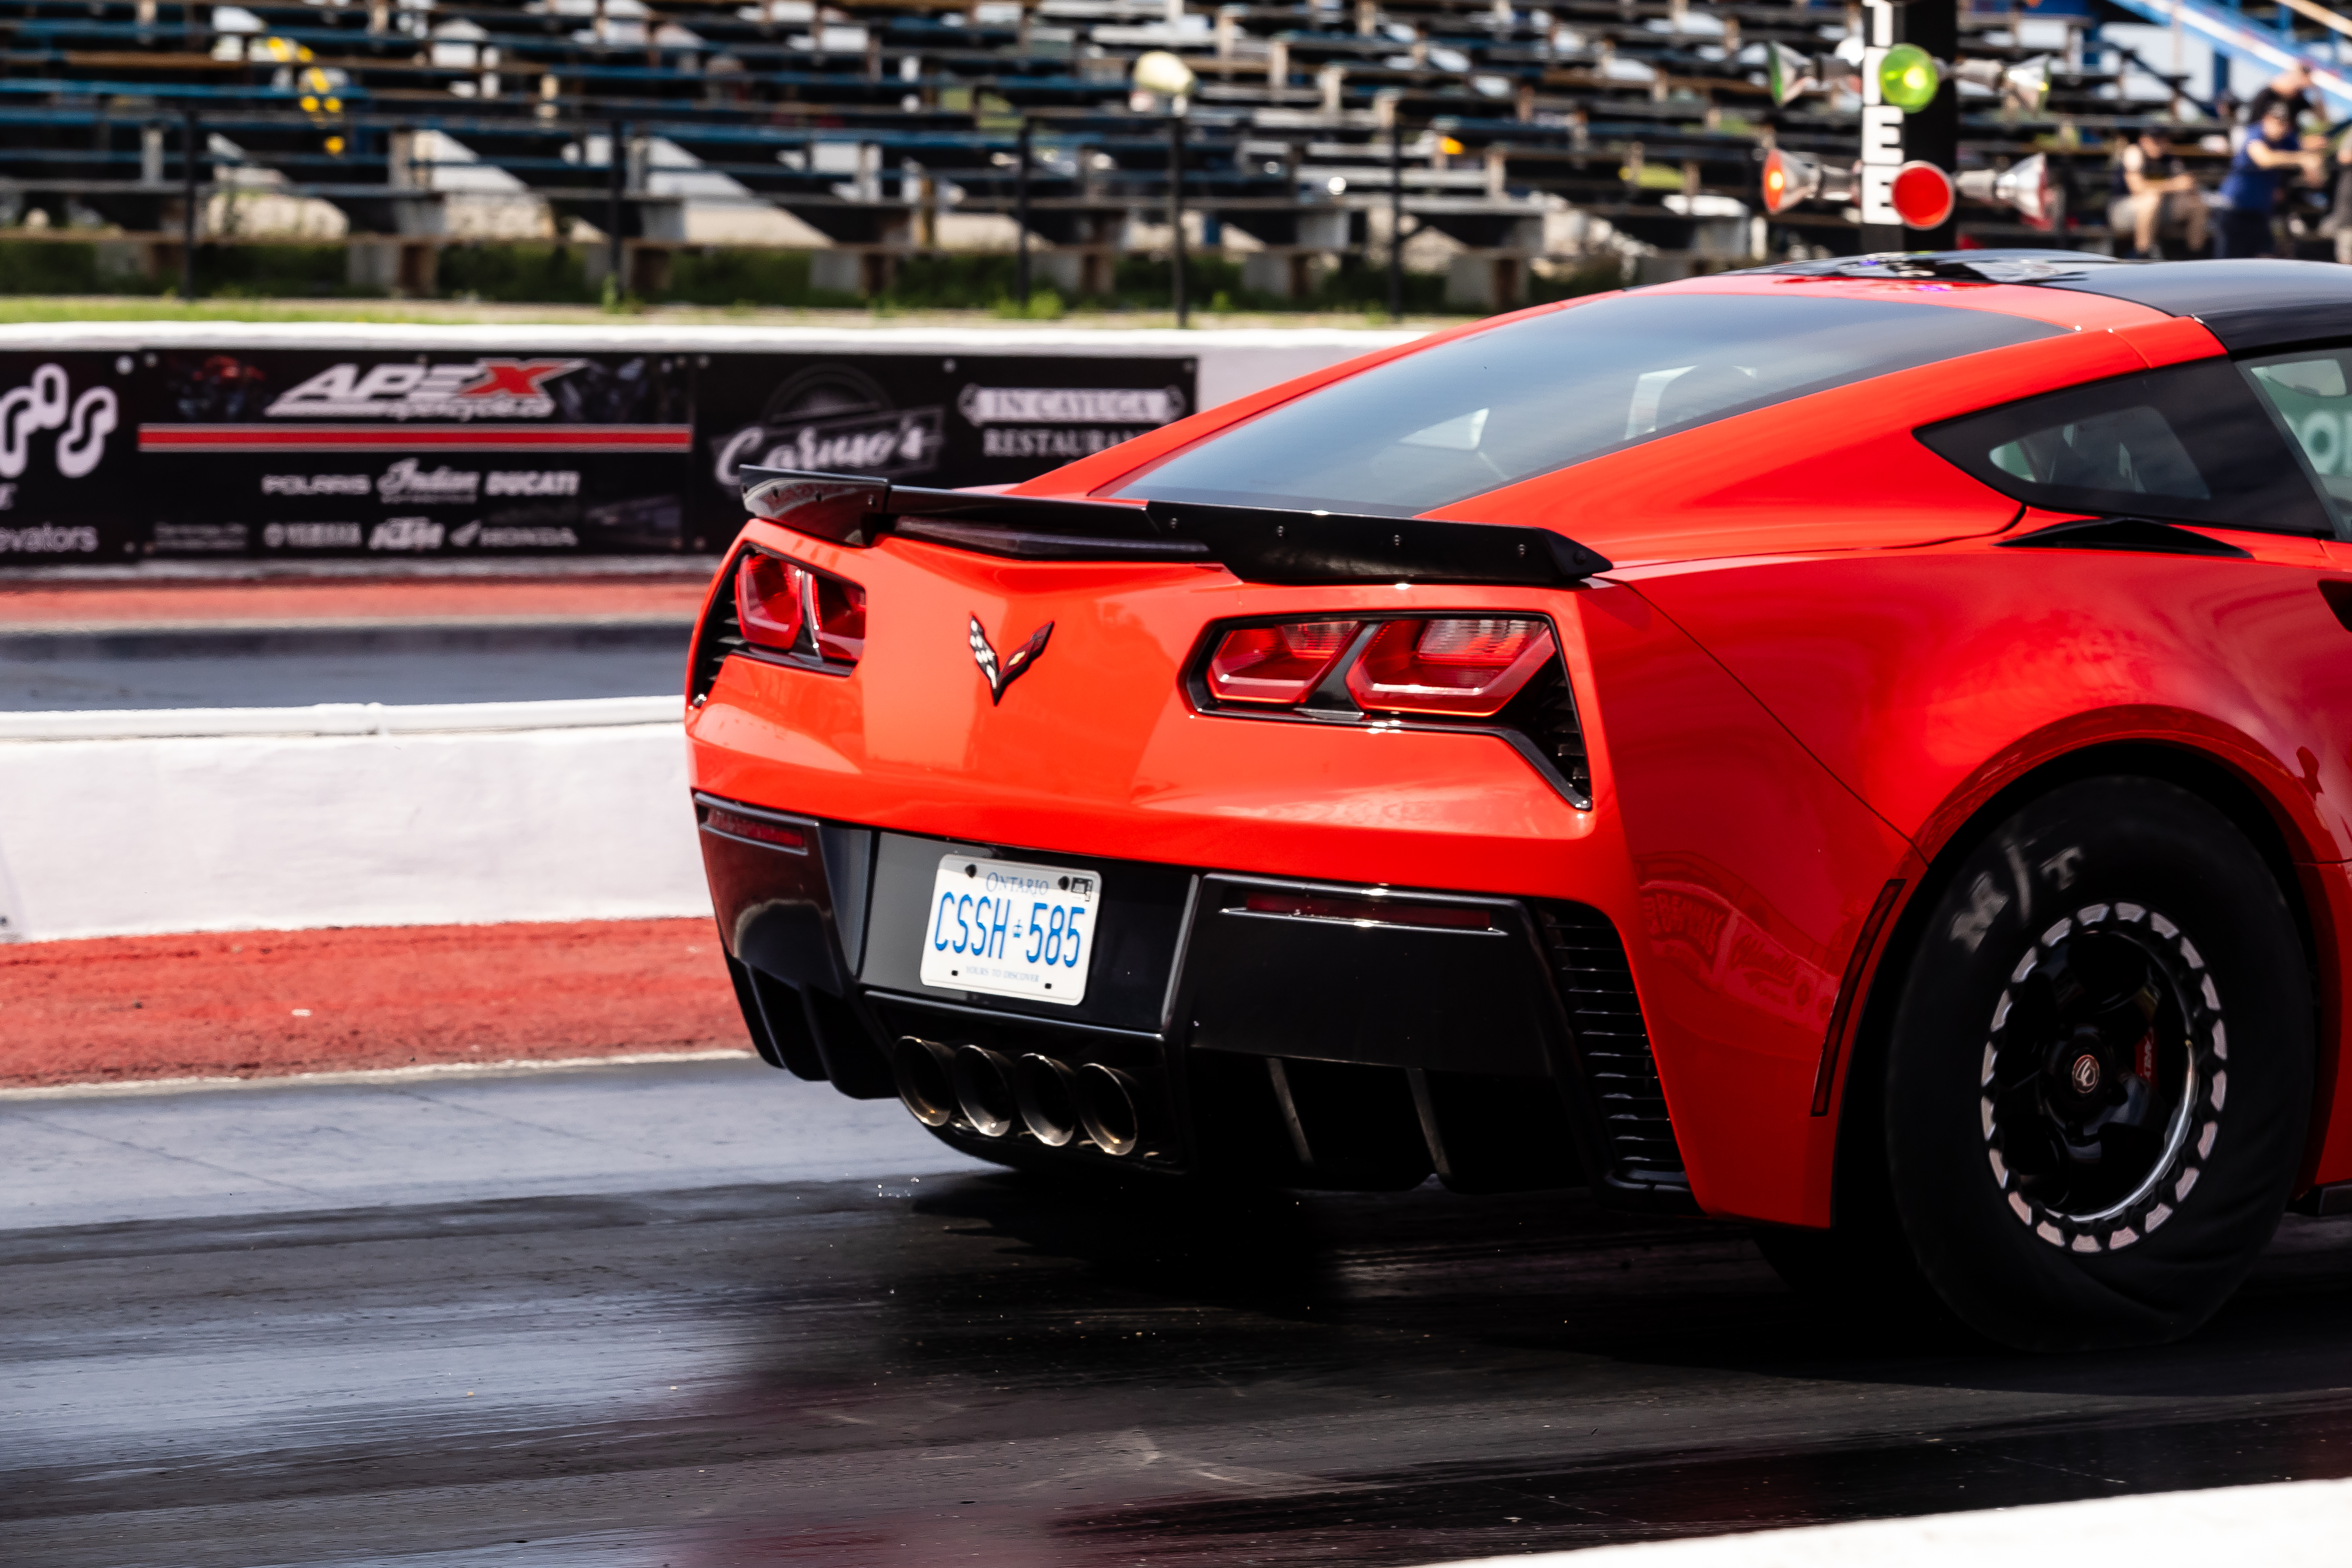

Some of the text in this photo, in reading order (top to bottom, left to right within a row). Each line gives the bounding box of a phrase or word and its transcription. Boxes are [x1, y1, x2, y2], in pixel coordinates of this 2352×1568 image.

[263, 358, 586, 417] APEX
[983, 428, 1151, 457] RESTAURA
[485, 471, 580, 495] DUCATI
[986, 871, 1049, 896] ONTARIO
[934, 891, 1085, 968] CSSH 585
